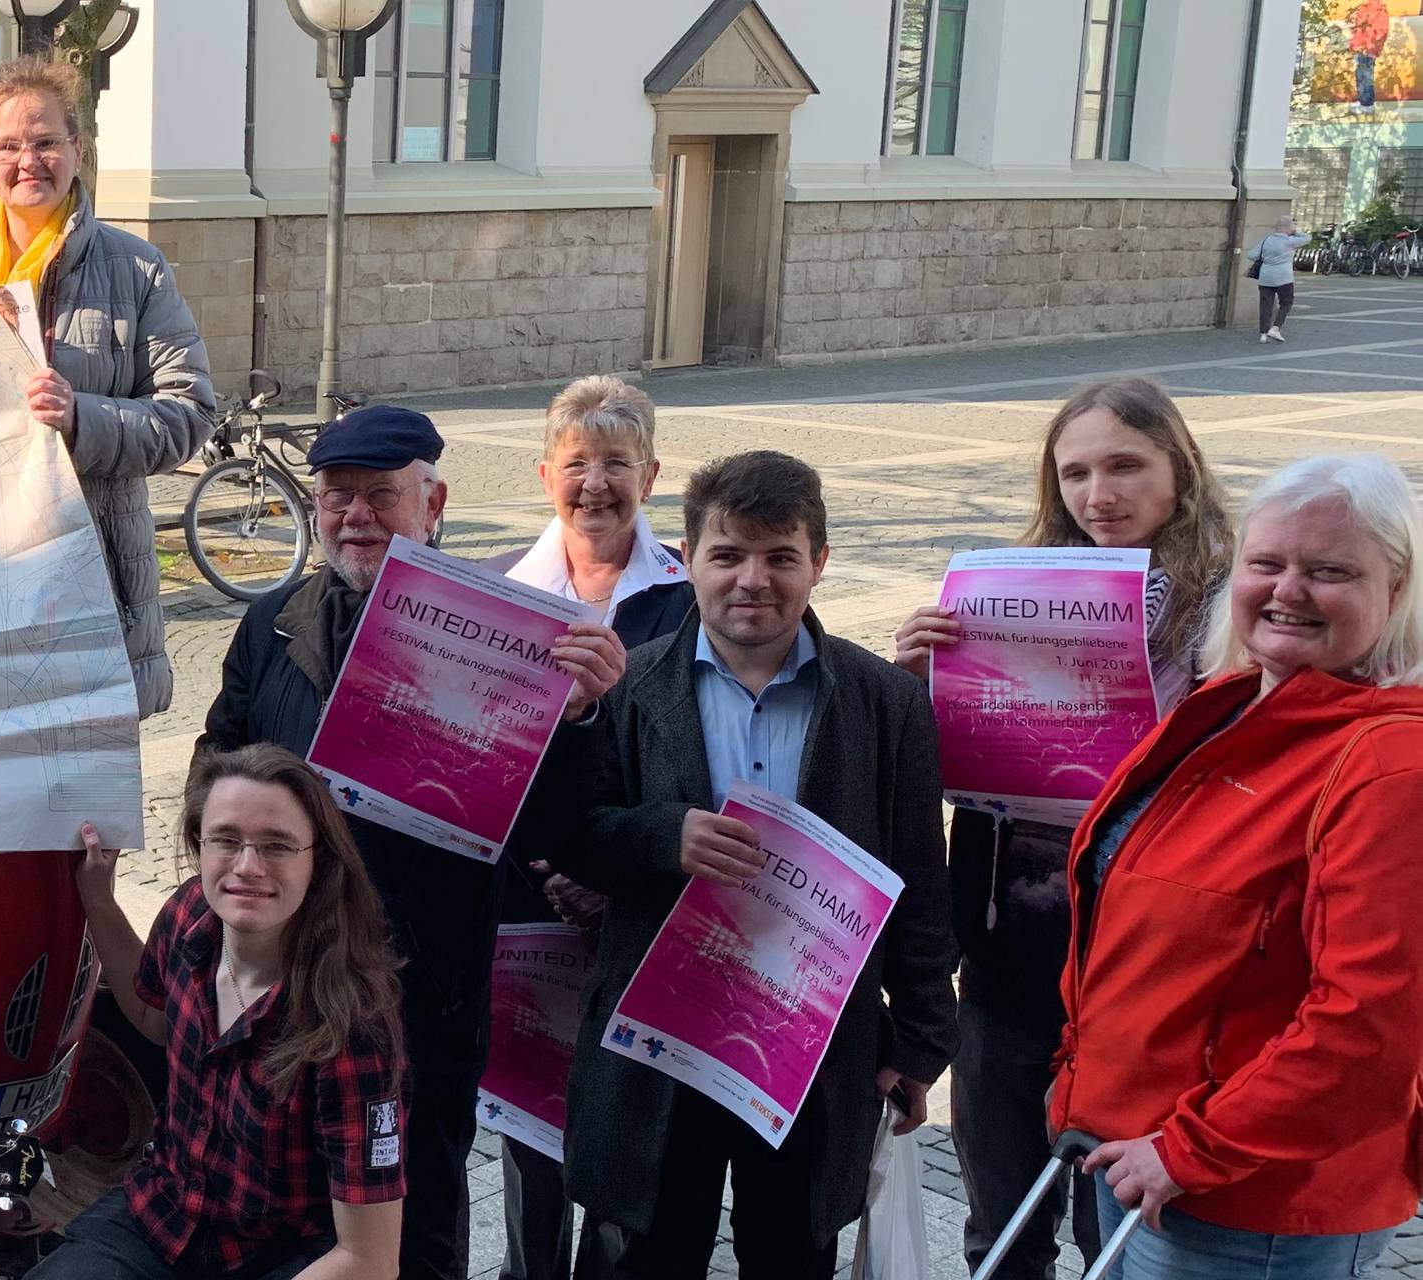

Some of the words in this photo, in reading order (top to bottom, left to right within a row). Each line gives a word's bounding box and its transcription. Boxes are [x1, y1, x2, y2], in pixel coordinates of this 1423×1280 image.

[381, 588, 481, 642] UNITED
[946, 597, 1039, 619] UNITED
[1049, 600, 1134, 623] HAMM
[957, 630, 1010, 642] FESTIVAL
[1011, 632, 1030, 643] für
[1030, 634, 1128, 650] Junggebliebene
[383, 627, 435, 655] FESTIVAL
[438, 648, 457, 662] für
[456, 655, 552, 699] Junggebliebene
[1056, 655, 1068, 668] 1.
[1070, 656, 1098, 669] Juni
[1102, 658, 1136, 672] 2019
[1079, 674, 1113, 686] 11-23
[469, 681, 480, 693] 1.
[482, 685, 511, 706] Juni
[511, 697, 545, 722] 2019
[482, 704, 514, 728] 11-23
[755, 845, 809, 890] TED
[810, 880, 871, 942] HAMM
[764, 892, 782, 911] für
[780, 903, 851, 963] Junggebliebene
[788, 935, 797, 950] 1.
[797, 942, 822, 966] Juni
[818, 959, 843, 987] 2019
[795, 964, 819, 990] 11-23
